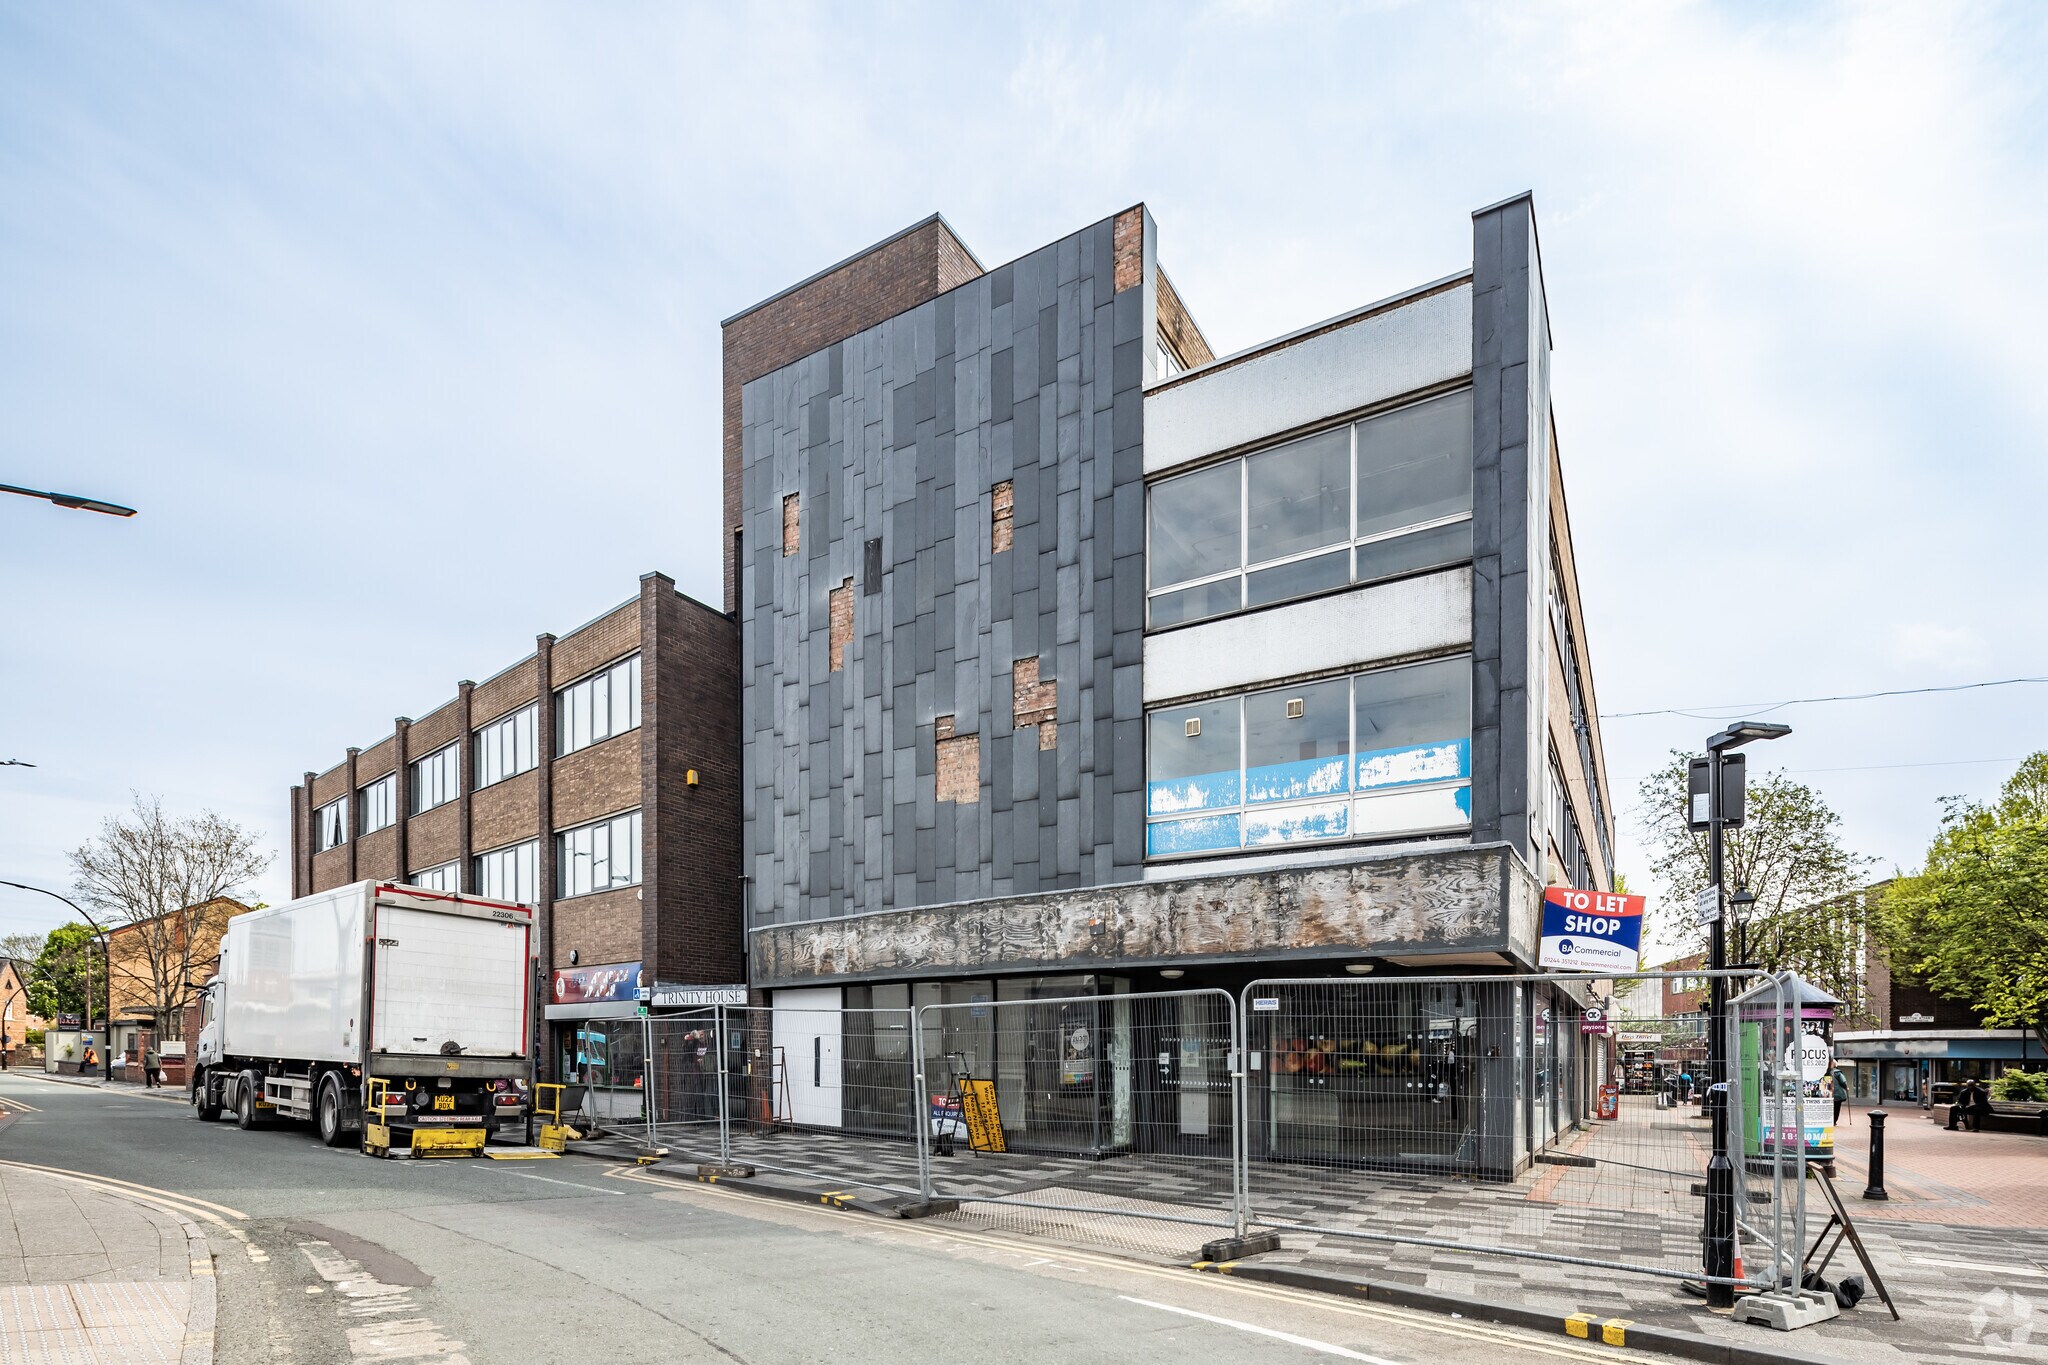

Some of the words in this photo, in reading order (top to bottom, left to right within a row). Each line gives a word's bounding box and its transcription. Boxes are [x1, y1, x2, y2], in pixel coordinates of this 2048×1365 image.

[1563, 891, 1590, 910] TO
[1596, 894, 1628, 913] LET
[492, 910, 514, 919] 22306
[1564, 914, 1621, 935] SHOP
[1574, 945, 1621, 957] Commercial
[1543, 956, 1560, 965] 01244
[1561, 957, 1578, 966] 351212
[1580, 960, 1632, 971] bacommercial.com
[662, 990, 701, 1004] TRINITY
[705, 990, 741, 1004] HOUSE
